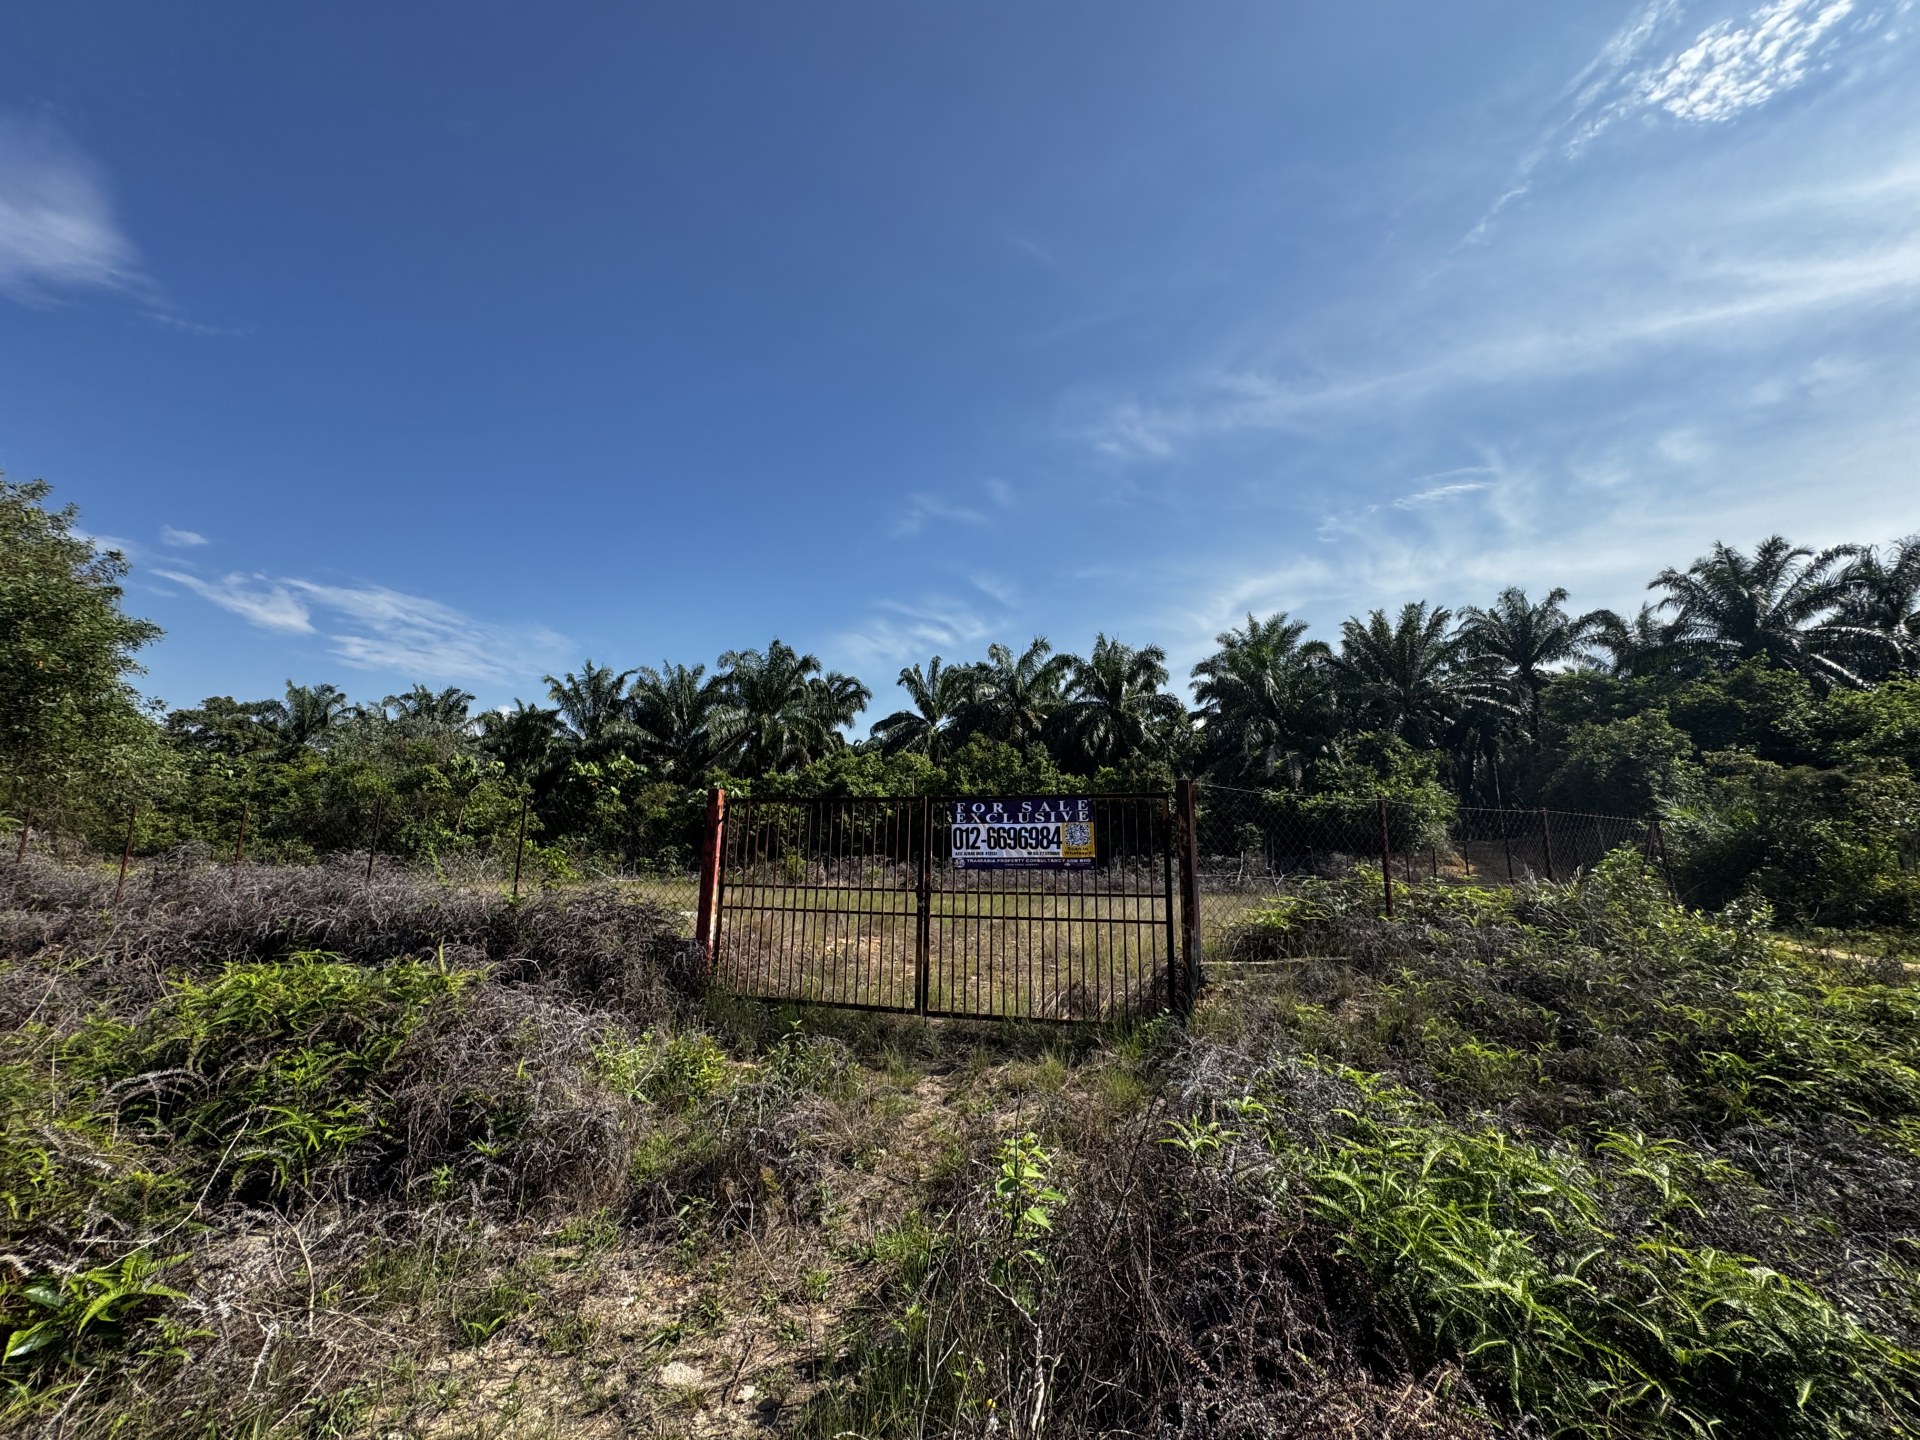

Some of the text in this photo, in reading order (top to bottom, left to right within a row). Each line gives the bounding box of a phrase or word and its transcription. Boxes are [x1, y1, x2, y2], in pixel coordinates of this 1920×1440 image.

[956, 800, 1089, 813] FOR SALE
[956, 811, 1089, 823] EXCLUSIVE
[952, 826, 1063, 850] 012-6696984
